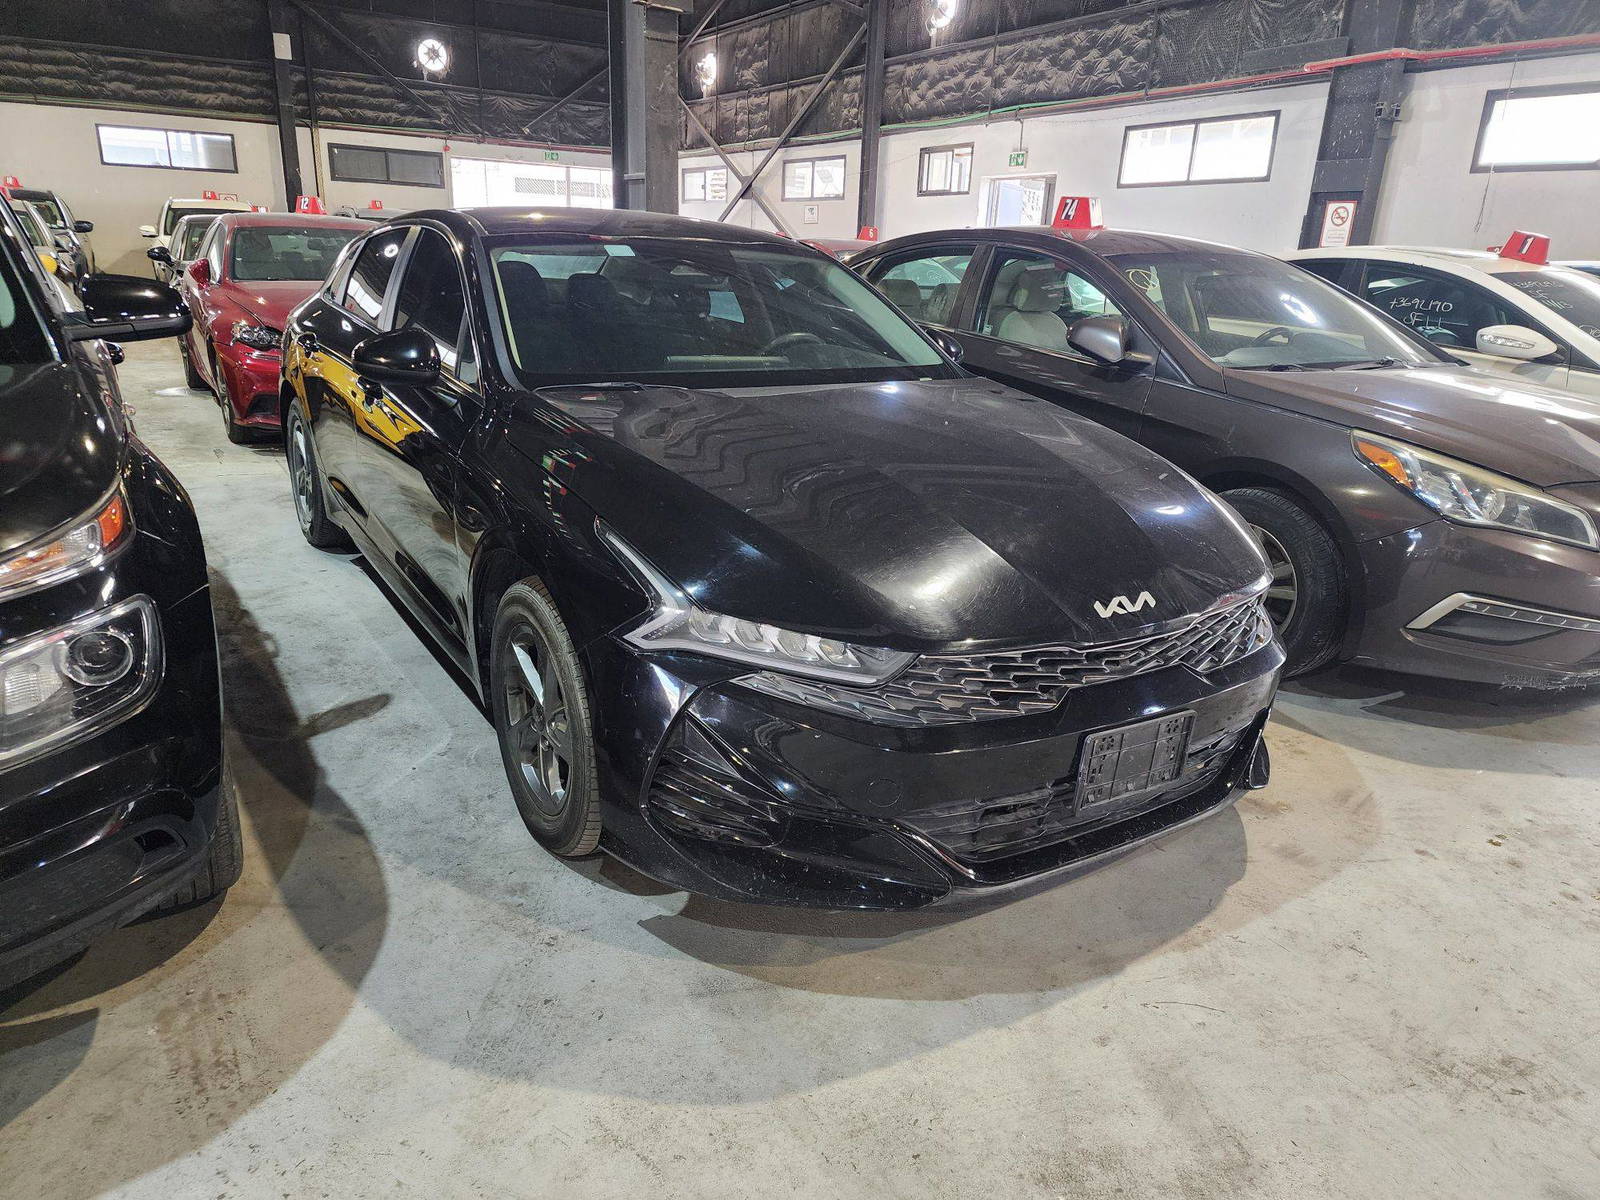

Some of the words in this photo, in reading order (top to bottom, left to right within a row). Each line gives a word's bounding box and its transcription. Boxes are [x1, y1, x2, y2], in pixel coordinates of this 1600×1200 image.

[300, 197, 309, 210] 12
[1061, 199, 1079, 220] 74
[1520, 236, 1535, 255] 1
[1093, 590, 1157, 619] KIA
